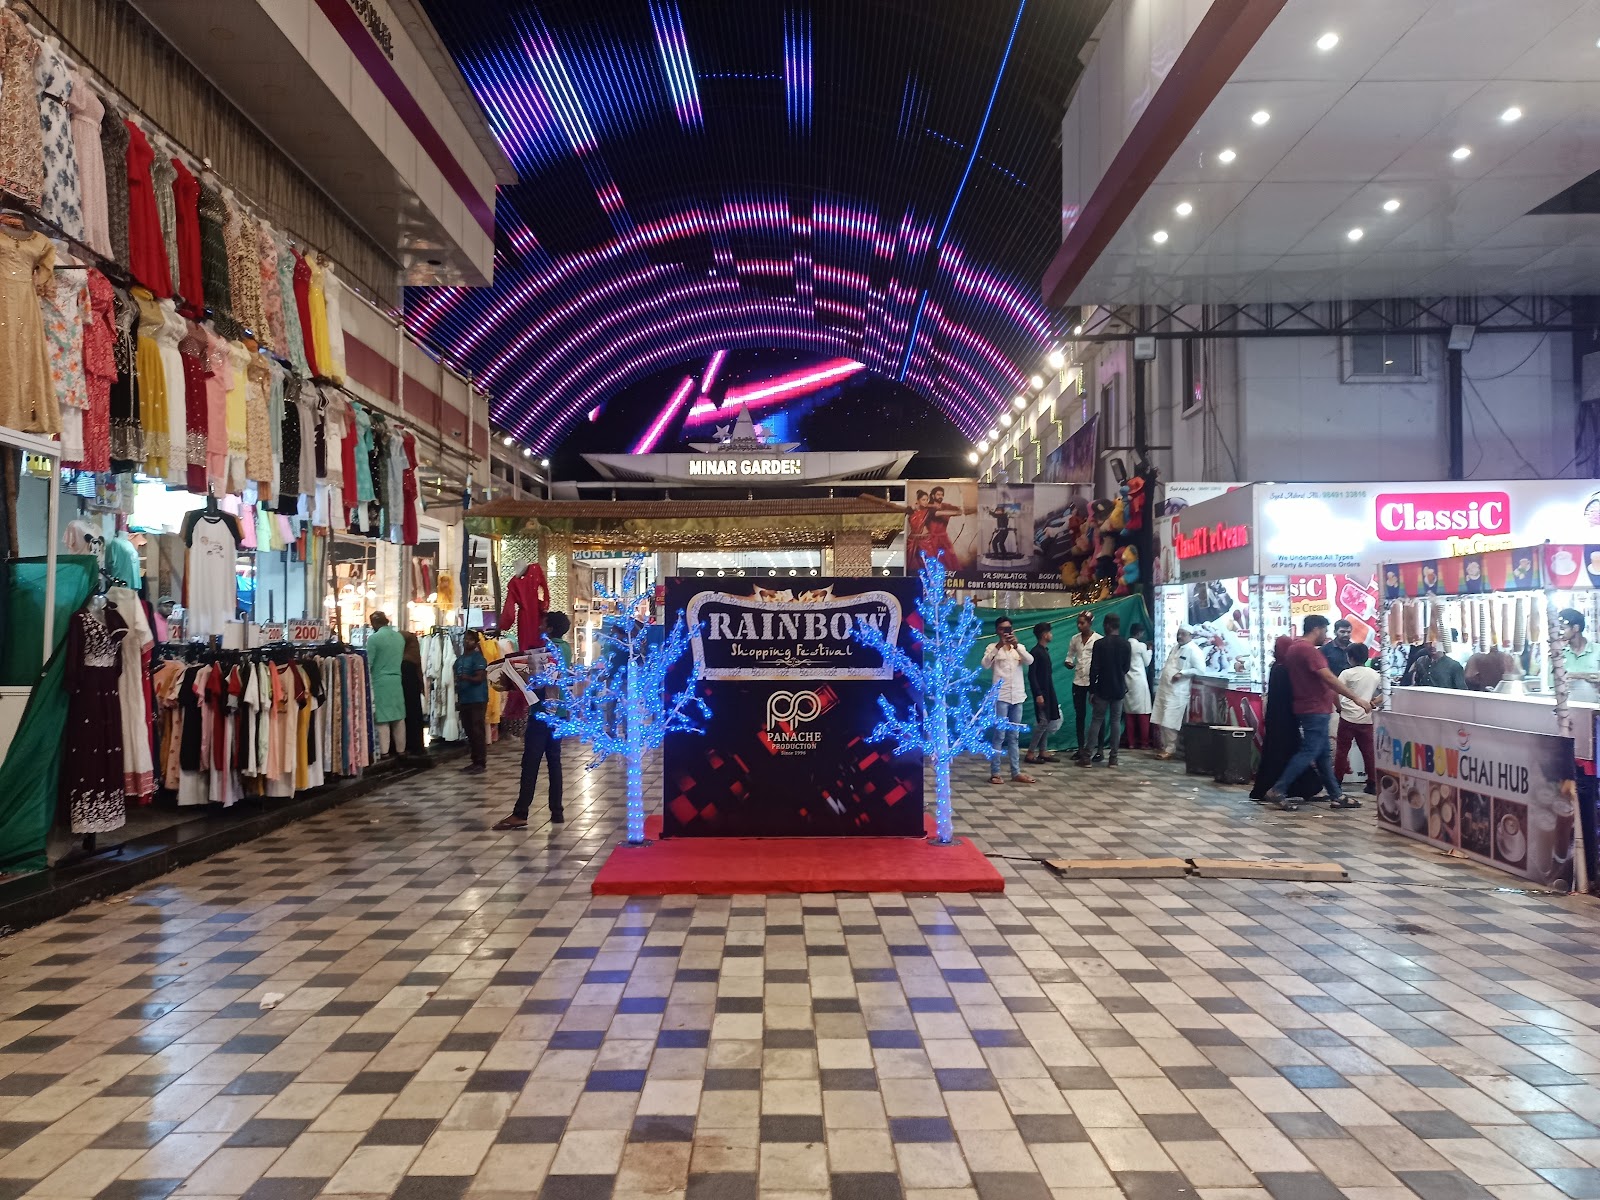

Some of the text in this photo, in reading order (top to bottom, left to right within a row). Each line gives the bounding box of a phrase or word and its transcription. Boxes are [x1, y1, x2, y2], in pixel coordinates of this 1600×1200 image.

[689, 460, 801, 475] MINAR GARDEN
[982, 572, 1028, 580] VR SIMULATOR
[1302, 602, 1329, 614] Cream
[708, 612, 887, 641] RAINBOW
[731, 643, 854, 660] Shopping Festival
[767, 732, 822, 742] PANACHE
[1392, 738, 1529, 795] RAINBOW CHAI HUB
